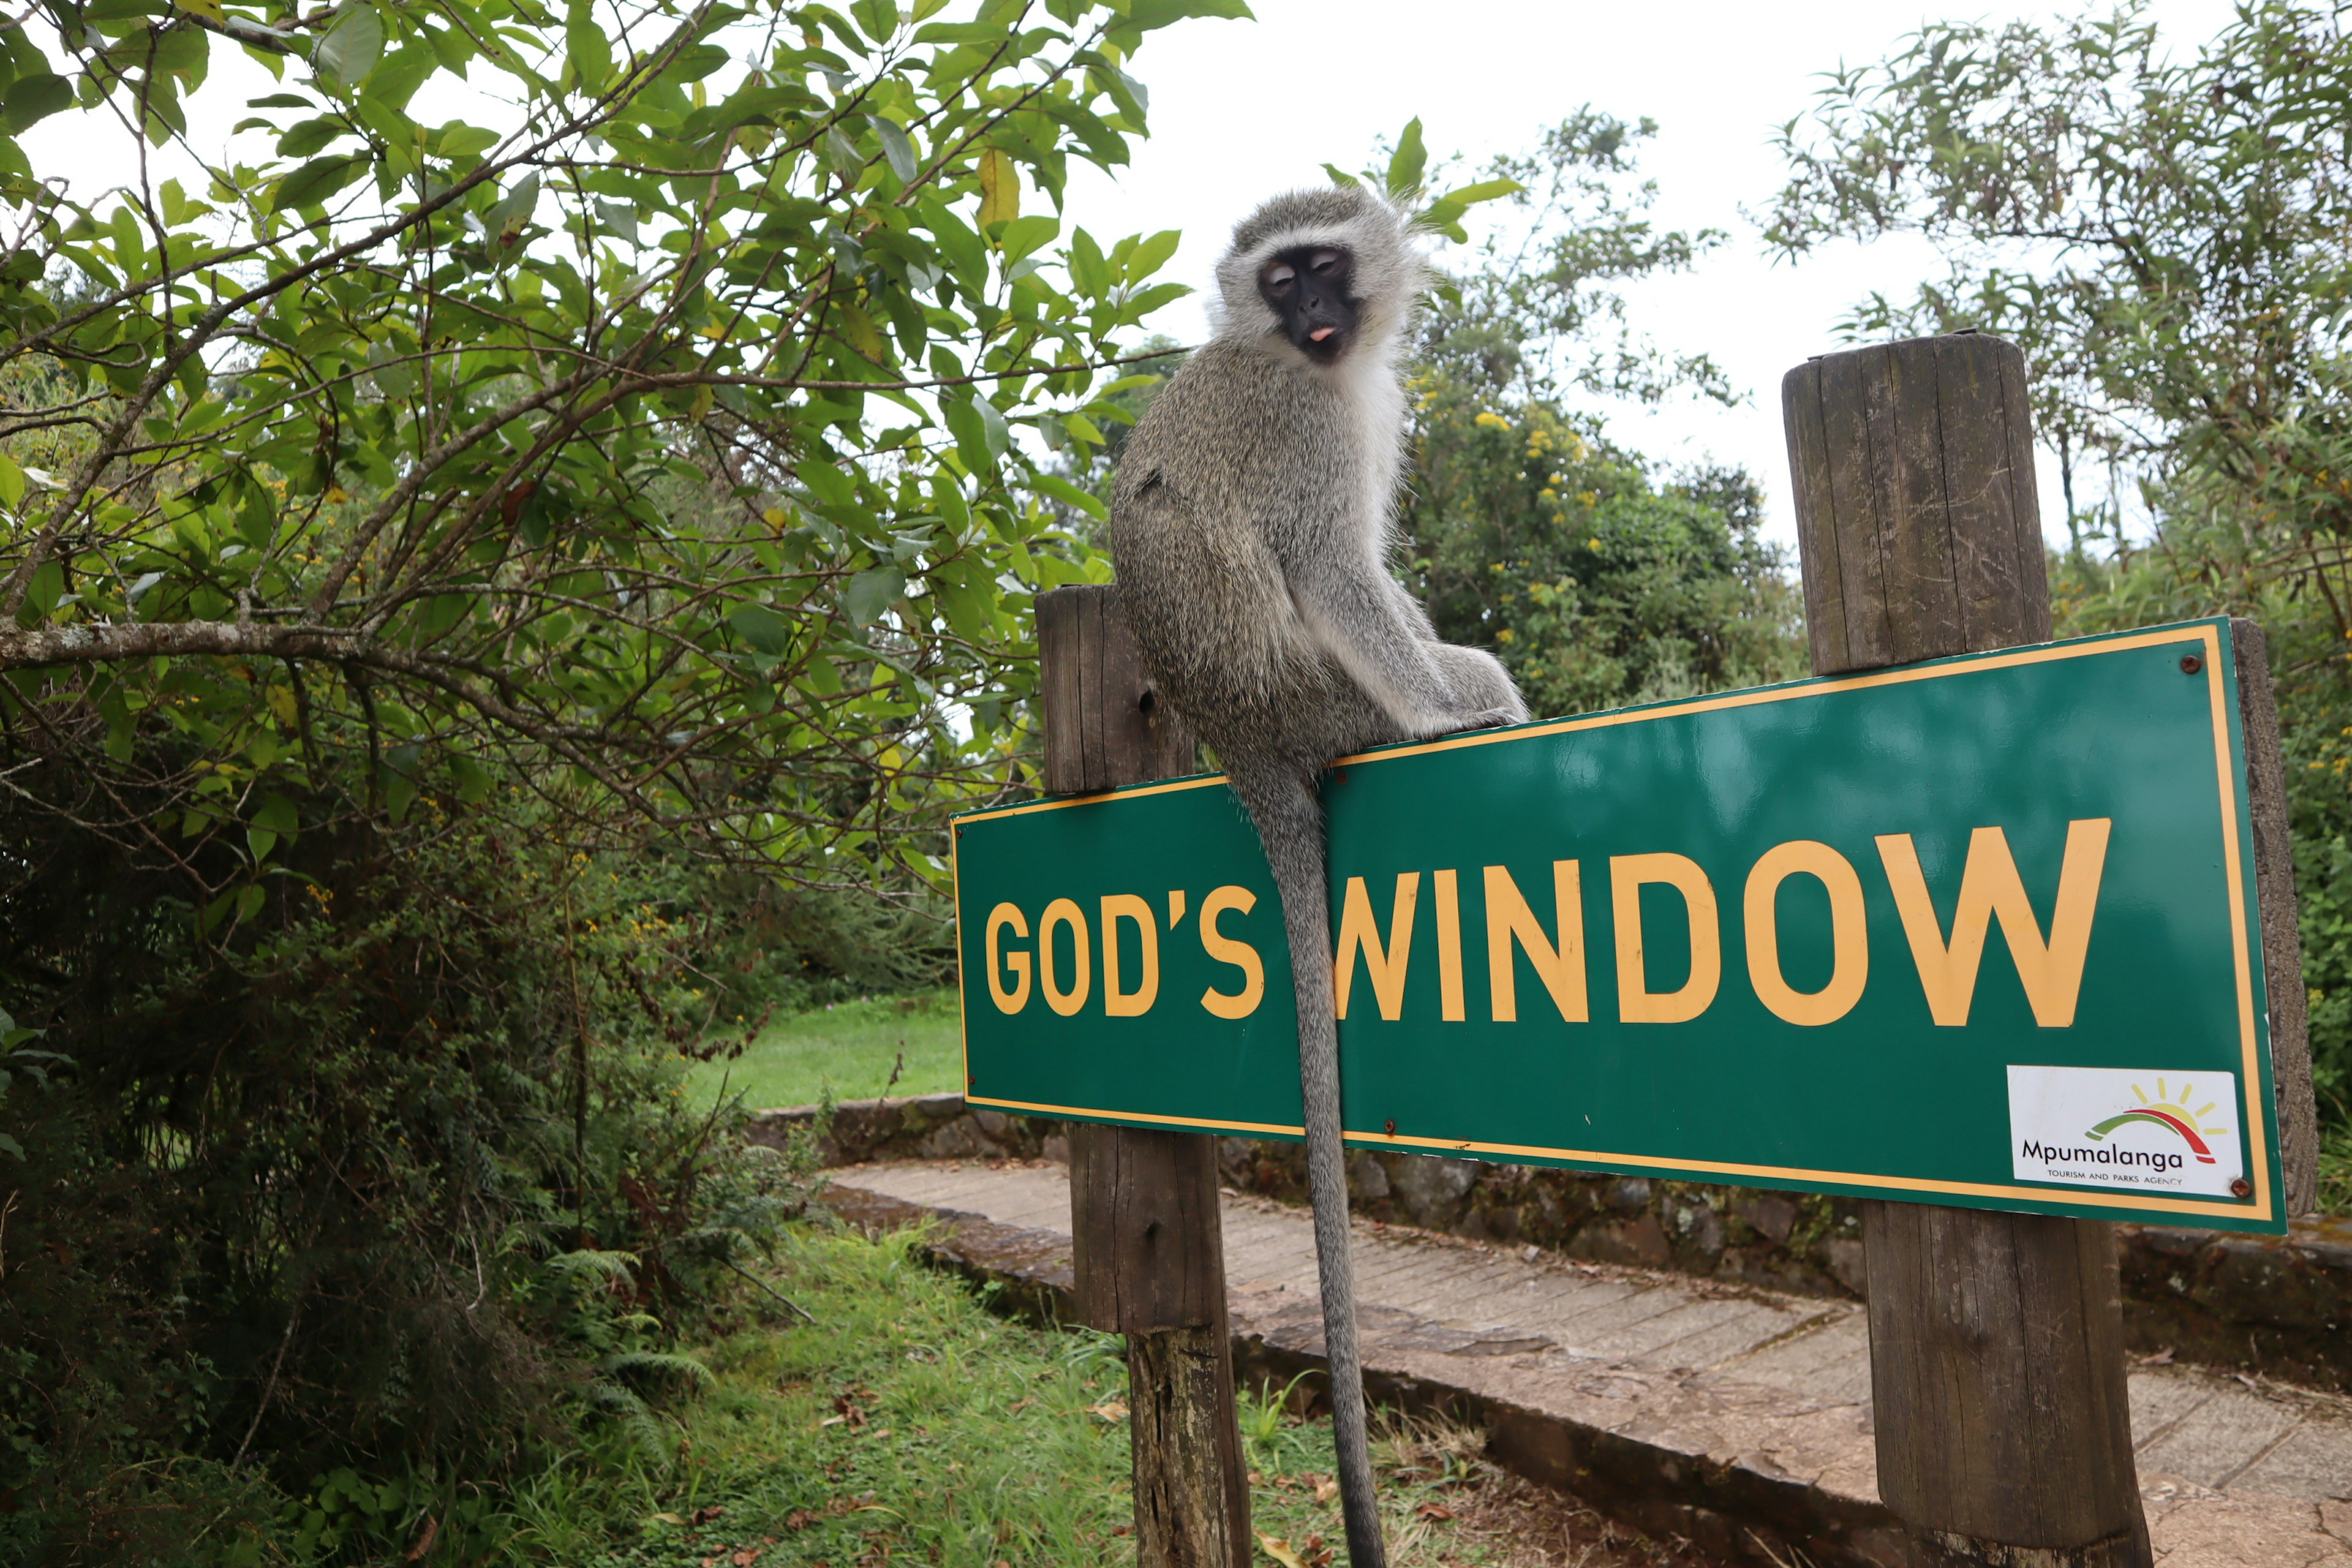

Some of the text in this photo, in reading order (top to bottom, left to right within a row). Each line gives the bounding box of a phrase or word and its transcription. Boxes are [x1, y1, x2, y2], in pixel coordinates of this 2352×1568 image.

[986, 818, 2111, 1028] GOD'S WINDOW
[2022, 1139, 2183, 1172] Mpumalanga
[2048, 1170, 2086, 1179] TOURISM
[2113, 1175, 2139, 1183] PARKS
[2144, 1177, 2183, 1186] AGENCY
